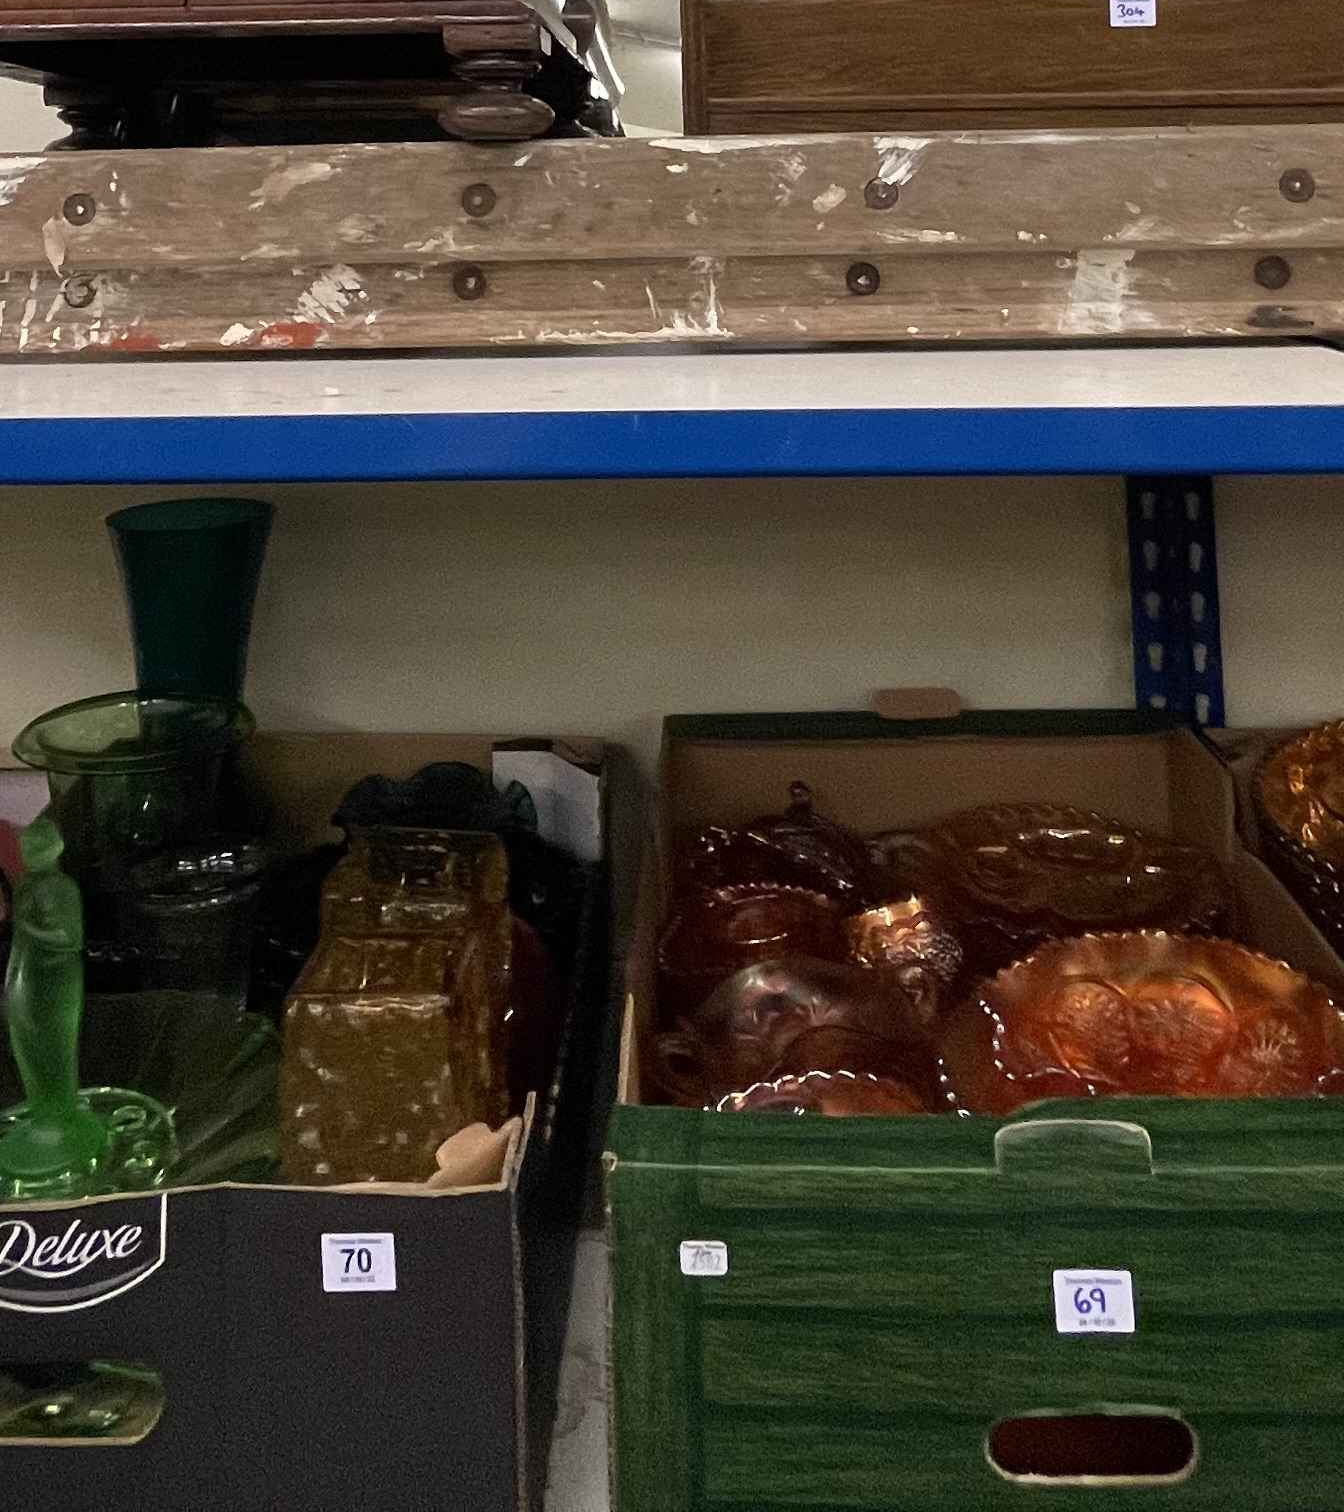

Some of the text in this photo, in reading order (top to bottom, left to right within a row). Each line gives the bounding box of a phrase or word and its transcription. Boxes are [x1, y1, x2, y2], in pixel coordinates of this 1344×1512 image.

[1117, 4, 1144, 18] 304
[340, 1247, 372, 1273] 70
[1074, 1287, 1106, 1314] 69
